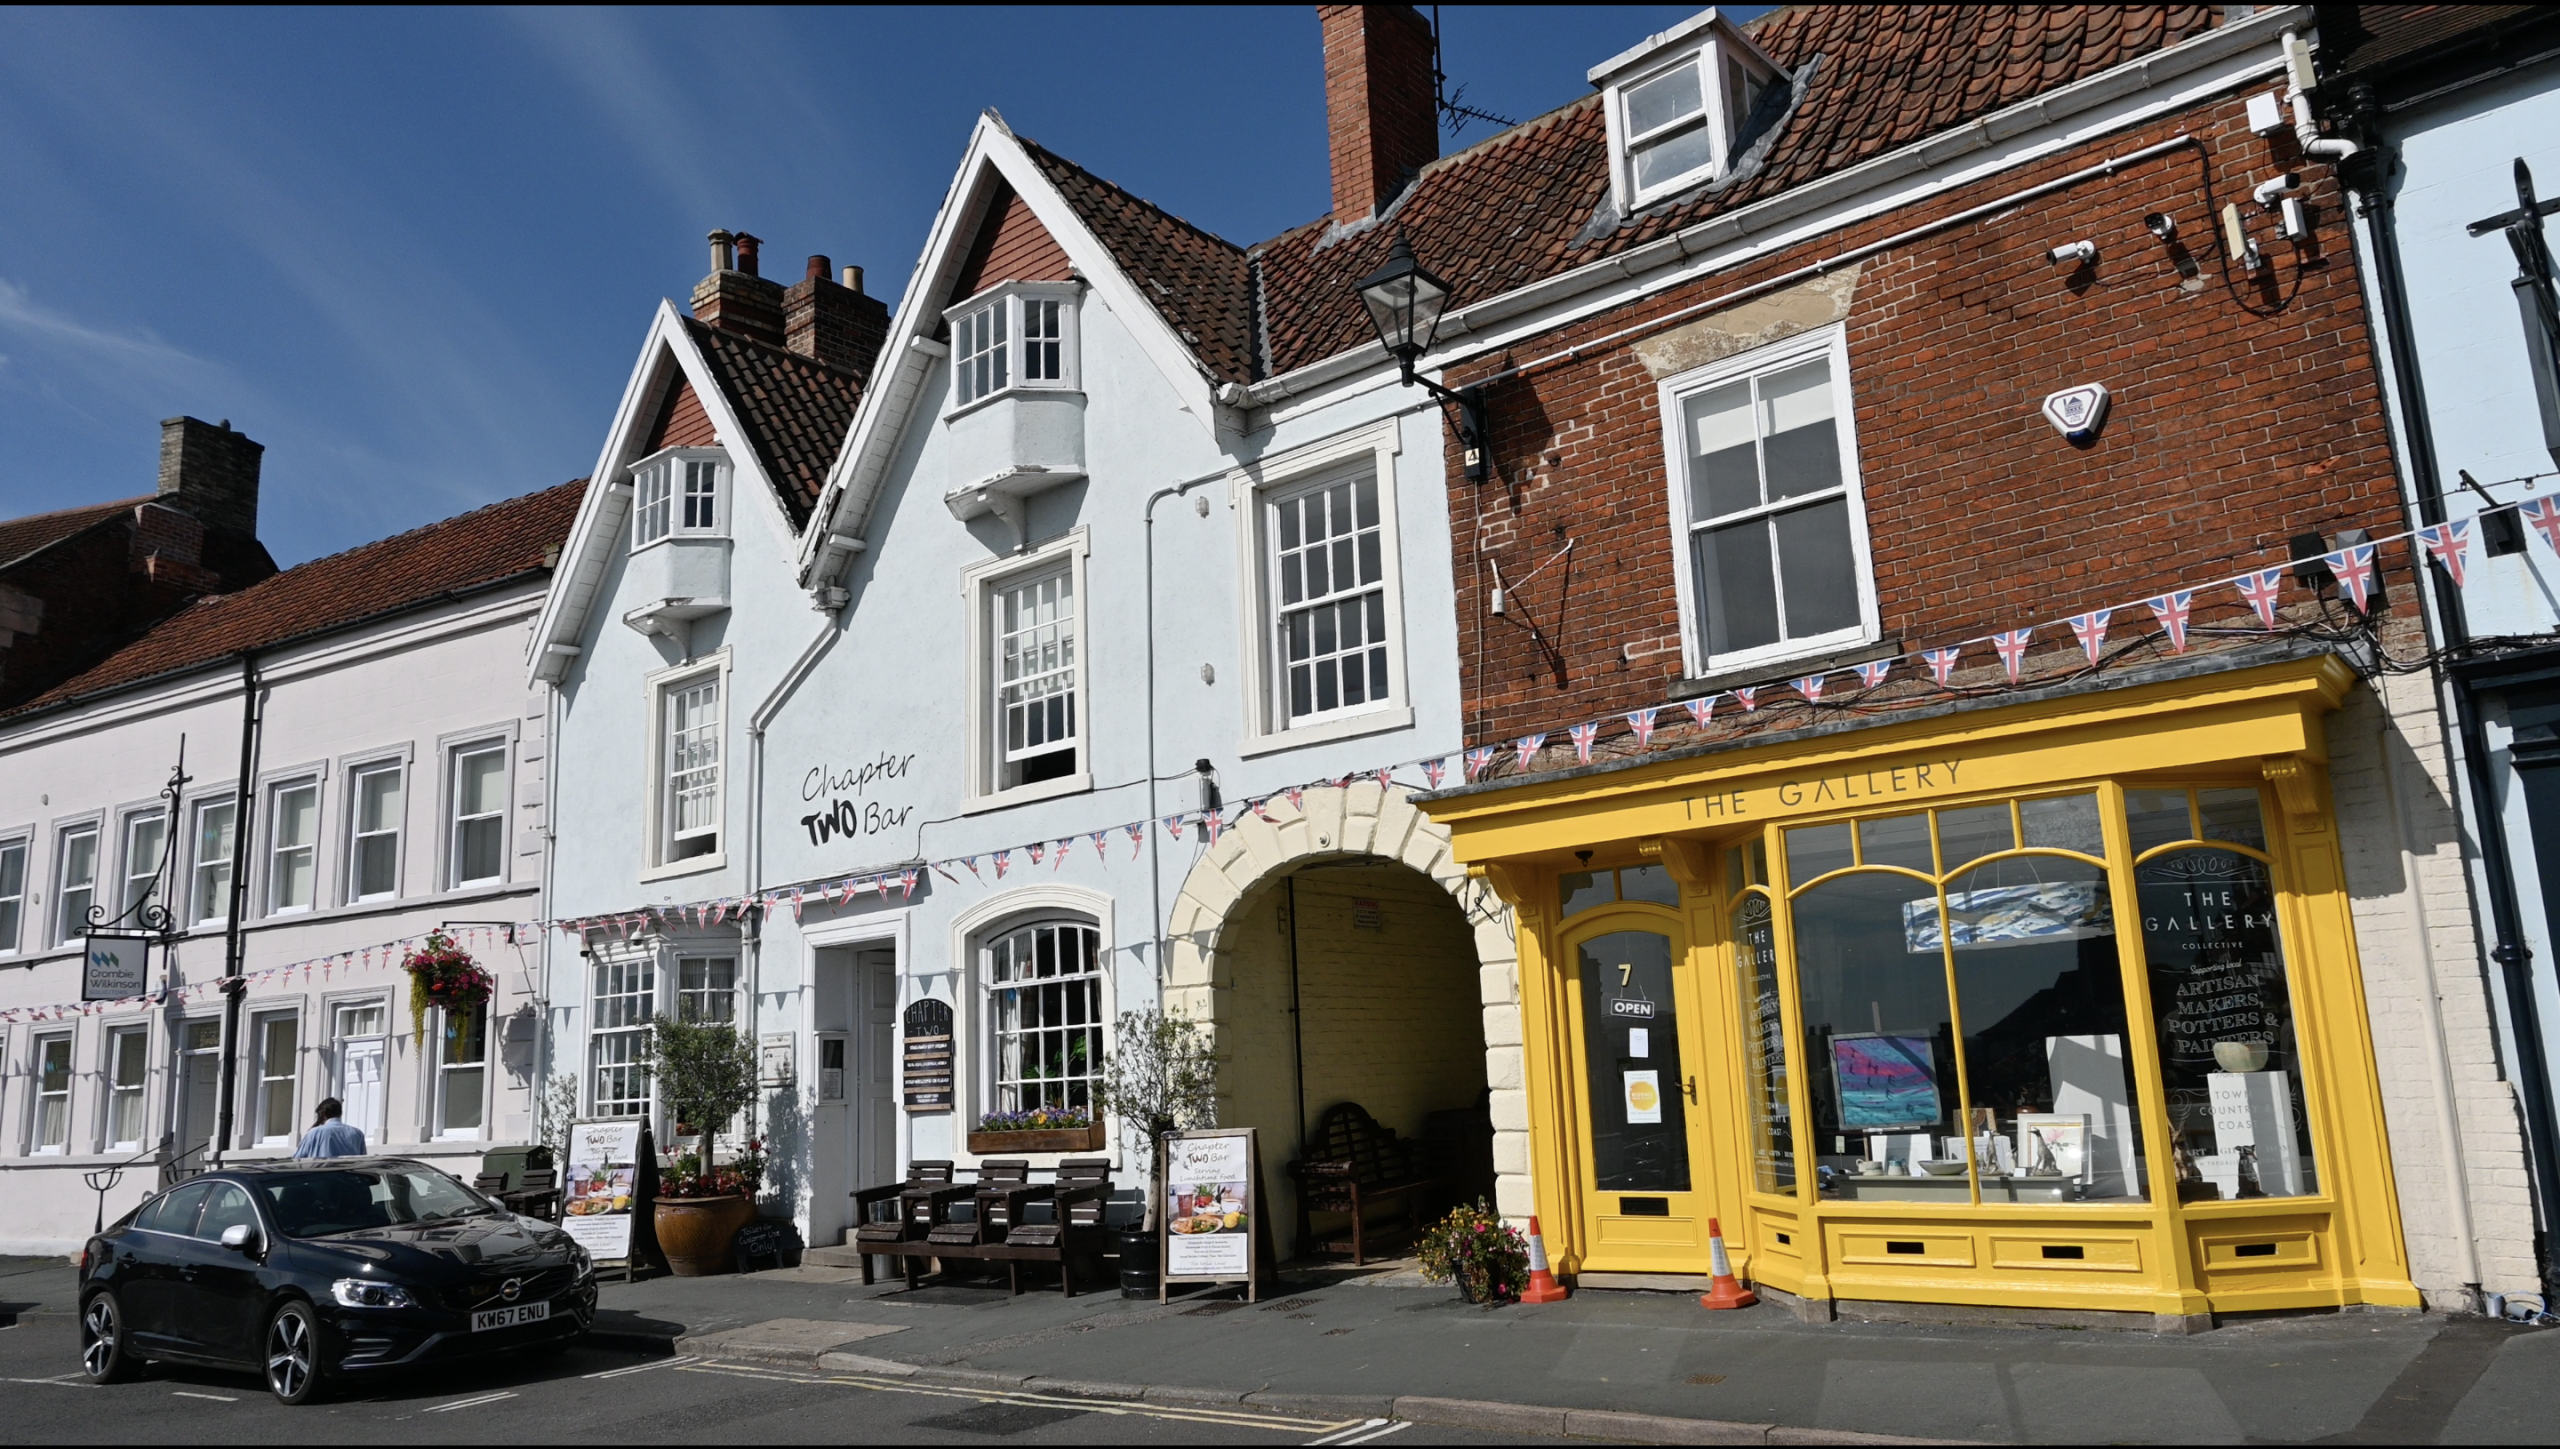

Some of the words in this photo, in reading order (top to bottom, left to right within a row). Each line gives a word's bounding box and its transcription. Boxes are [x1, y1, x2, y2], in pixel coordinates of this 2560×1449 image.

[802, 750, 915, 801] Chapter
[1681, 789, 1747, 821] THE
[1778, 758, 1962, 807] GALLERY
[800, 798, 857, 847] TWO
[864, 801, 913, 835] Bar
[2183, 892, 2231, 907] THE
[2145, 913, 2272, 932] GALLERY
[1748, 930, 1765, 945] THE
[2182, 942, 2244, 950] COLLECTIVE
[1737, 949, 1775, 968] GALLER
[90, 968, 134, 978] Crombie
[1618, 963, 1632, 987] 7
[90, 979, 140, 989] Wilkinson
[2176, 974, 2260, 996] ARTISAN
[906, 1000, 949, 1024] CHAPTER
[1614, 1002, 1651, 1015] OPEN
[2176, 993, 2264, 1015] MAKERS,
[2167, 1011, 2260, 1034] POTTERS
[2264, 1012, 2280, 1027] &
[2215, 1090, 2252, 1100] TOWN
[2200, 1105, 2258, 1116] COUNTRY
[586, 1126, 624, 1135] Chapter
[585, 1135, 605, 1147] TWO
[607, 1135, 623, 1144] Bar
[1187, 1142, 1230, 1153] Chapter
[1187, 1151, 1209, 1167] TWO
[1210, 1153, 1230, 1162] Bar
[739, 1233, 767, 1245] Customer
[749, 1238, 777, 1254] Only!
[477, 1309, 515, 1329] KW67
[518, 1303, 545, 1322] ENU
